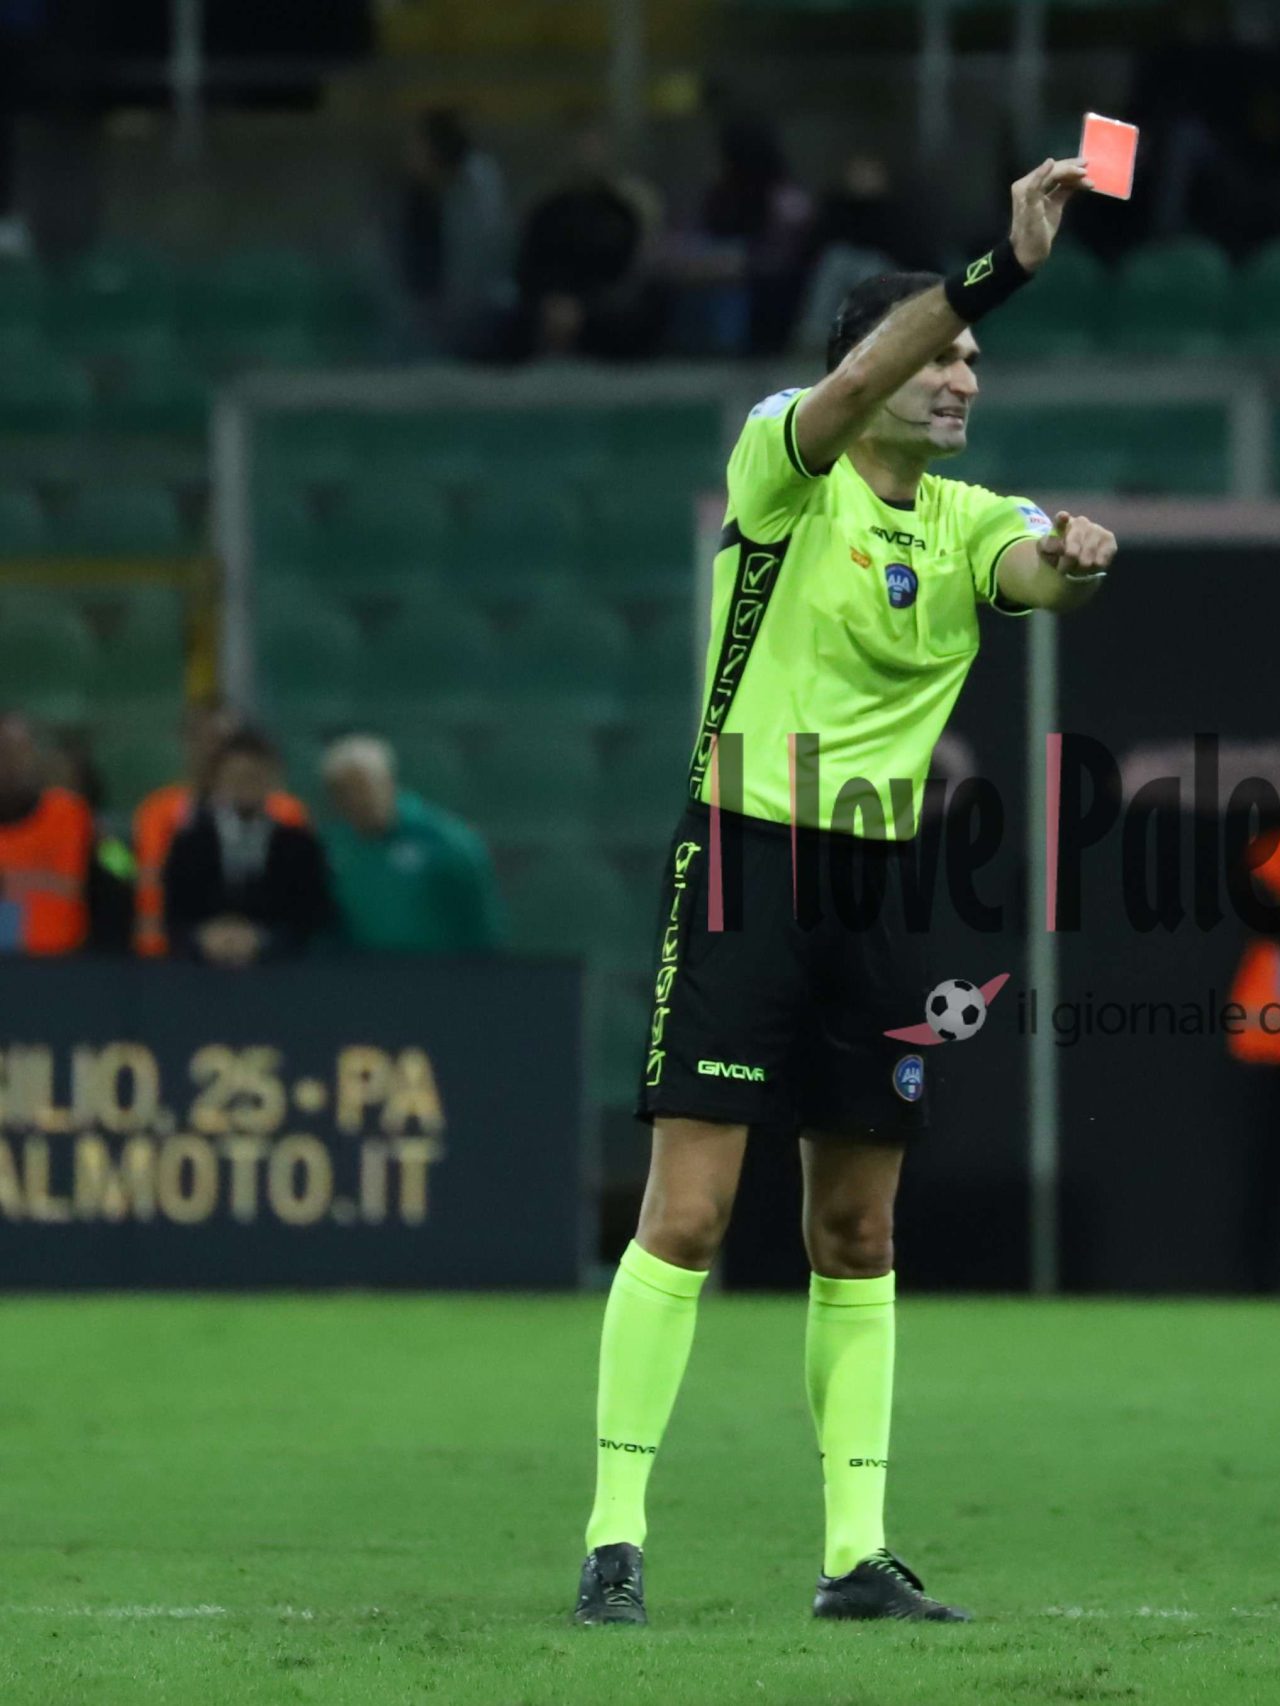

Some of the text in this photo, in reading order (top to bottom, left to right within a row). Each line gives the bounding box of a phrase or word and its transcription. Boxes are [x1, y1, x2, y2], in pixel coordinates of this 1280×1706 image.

[189, 1044, 287, 1134] 25
[336, 1045, 446, 1134] PA
[698, 1060, 766, 1082] GIVOVA
